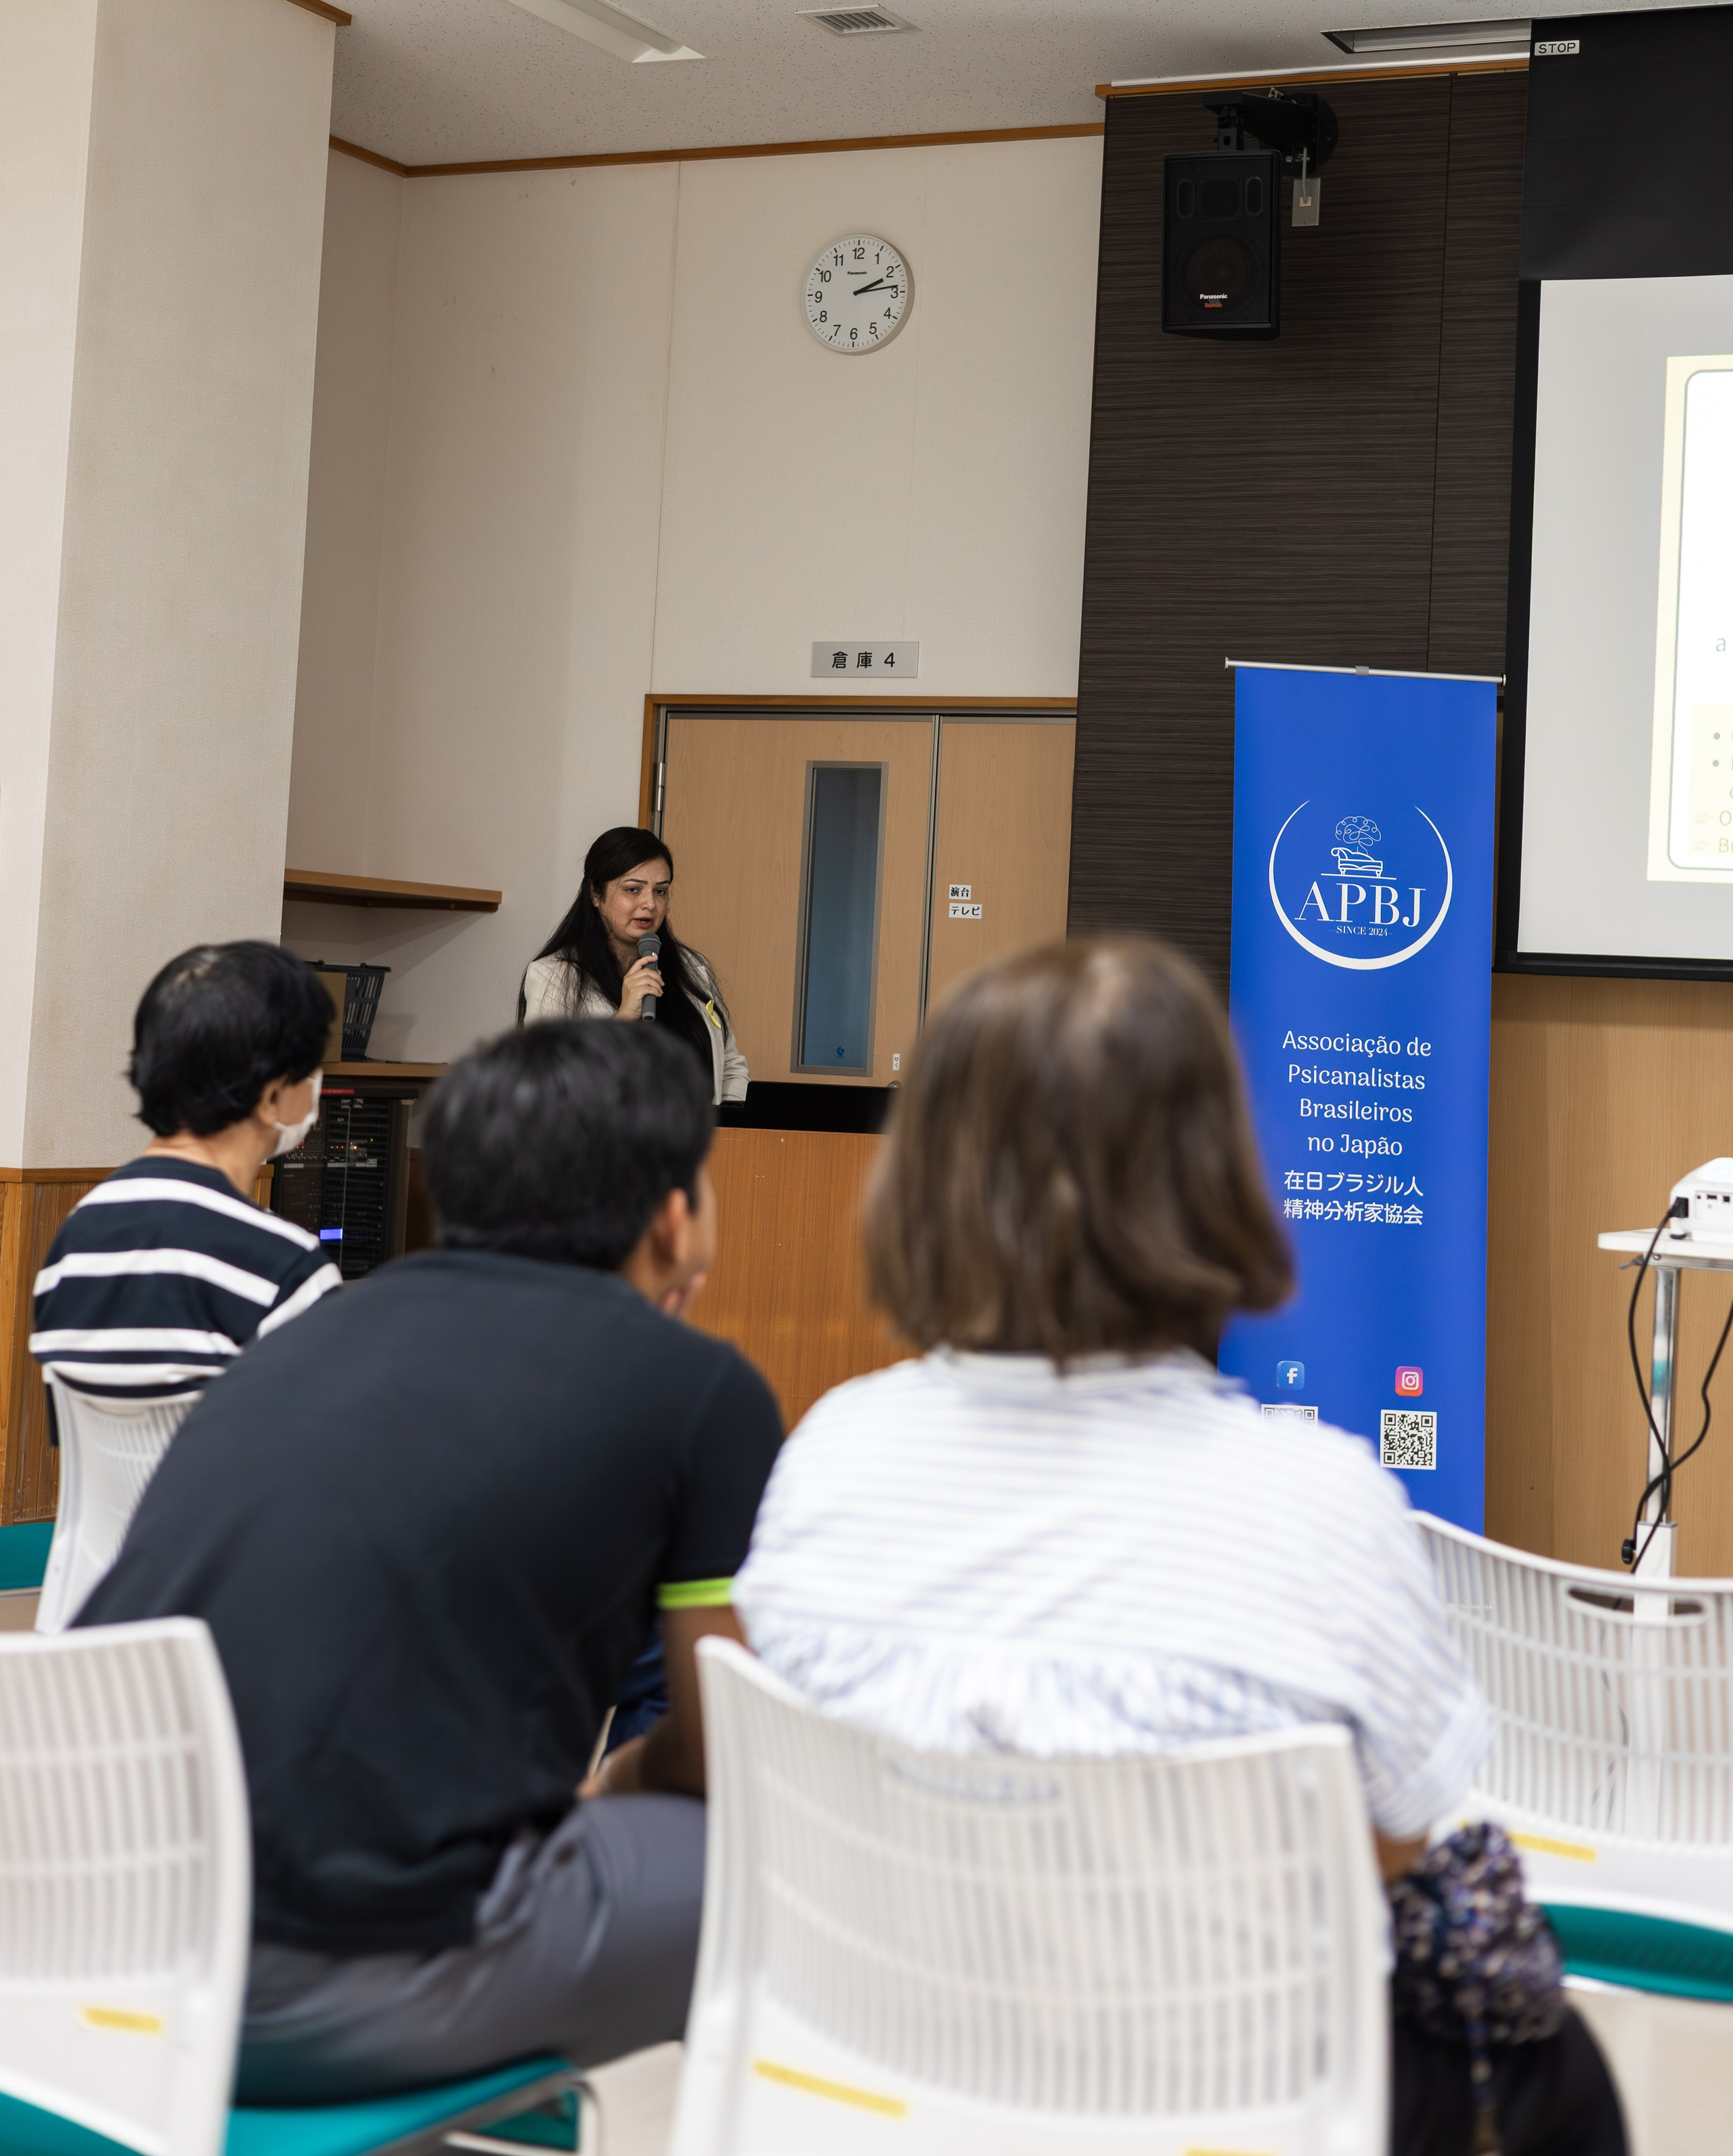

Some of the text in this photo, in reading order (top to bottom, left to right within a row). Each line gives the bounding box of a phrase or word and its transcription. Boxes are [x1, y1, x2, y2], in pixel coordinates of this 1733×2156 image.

[1538, 42, 1576, 54] STOP
[852, 246, 865, 260] 12
[875, 252, 880, 265] 1
[833, 254, 844, 267] 11
[818, 270, 832, 283] 10
[885, 265, 894, 278] 2
[814, 290, 823, 303] 9
[890, 286, 899, 299] 3
[819, 310, 828, 323] 8
[883, 307, 892, 320] 4
[833, 324, 841, 337] 7
[850, 327, 858, 341] 6
[869, 322, 877, 335] 5
[831, 651, 896, 669] 倉庫4
[1719, 838, 1733, 853] B
[1294, 880, 1426, 928] APBJ
[951, 906, 980, 916] テレビ
[1336, 926, 1388, 936] SINCE 2024
[1282, 1030, 1432, 1058] Associação de
[1288, 1064, 1426, 1090] Psicanalistas
[1300, 1098, 1413, 1123] Brasileiros
[1307, 1134, 1403, 1159] no Japão
[1284, 1169, 1424, 1196] 在日ブラジル人
[1283, 1197, 1424, 1226] 精神分析家協会
